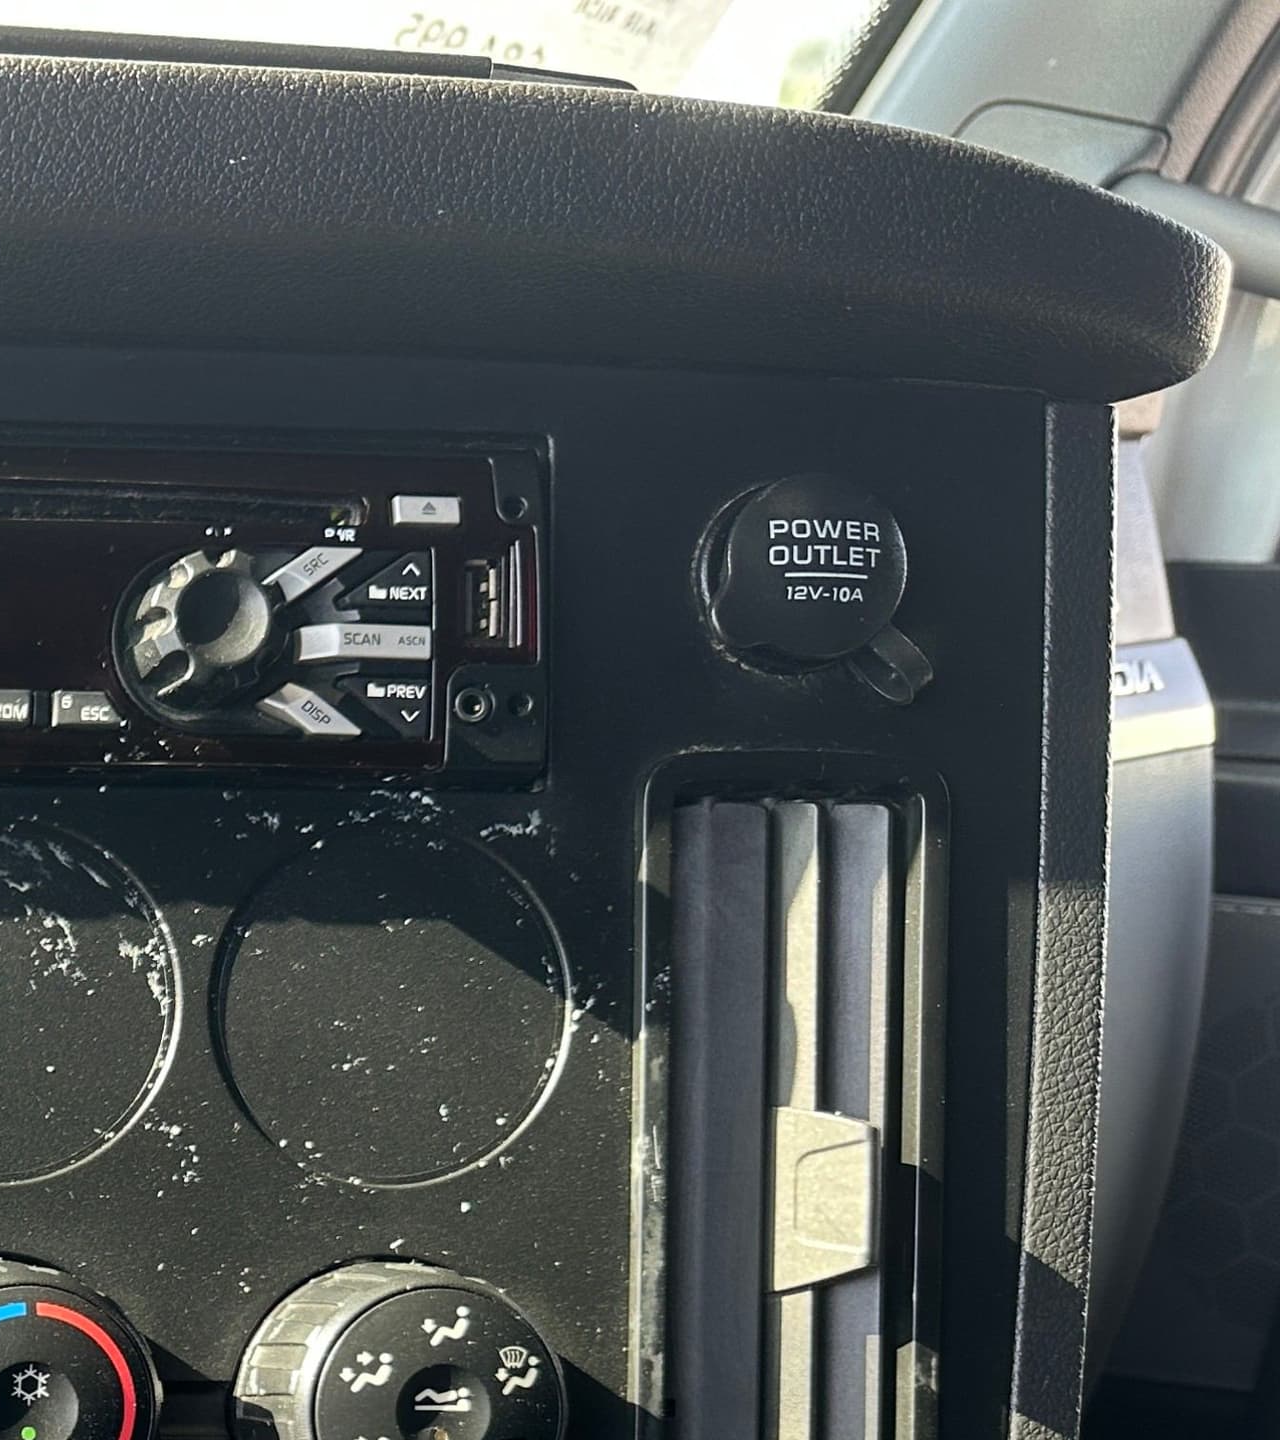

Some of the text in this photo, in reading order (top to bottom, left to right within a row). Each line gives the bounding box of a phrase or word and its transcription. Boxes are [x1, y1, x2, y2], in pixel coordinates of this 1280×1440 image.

[768, 519, 881, 542] POWER
[303, 552, 330, 576] SRC
[768, 545, 881, 568] OUTLET
[389, 587, 428, 600] NEXT
[785, 586, 863, 602] 12V-10A
[343, 632, 381, 647] SCAN
[398, 636, 426, 647] ASCN
[387, 684, 427, 699] PREV
[61, 695, 73, 709] 6
[80, 705, 111, 721] ESC
[301, 700, 332, 726] DISP
